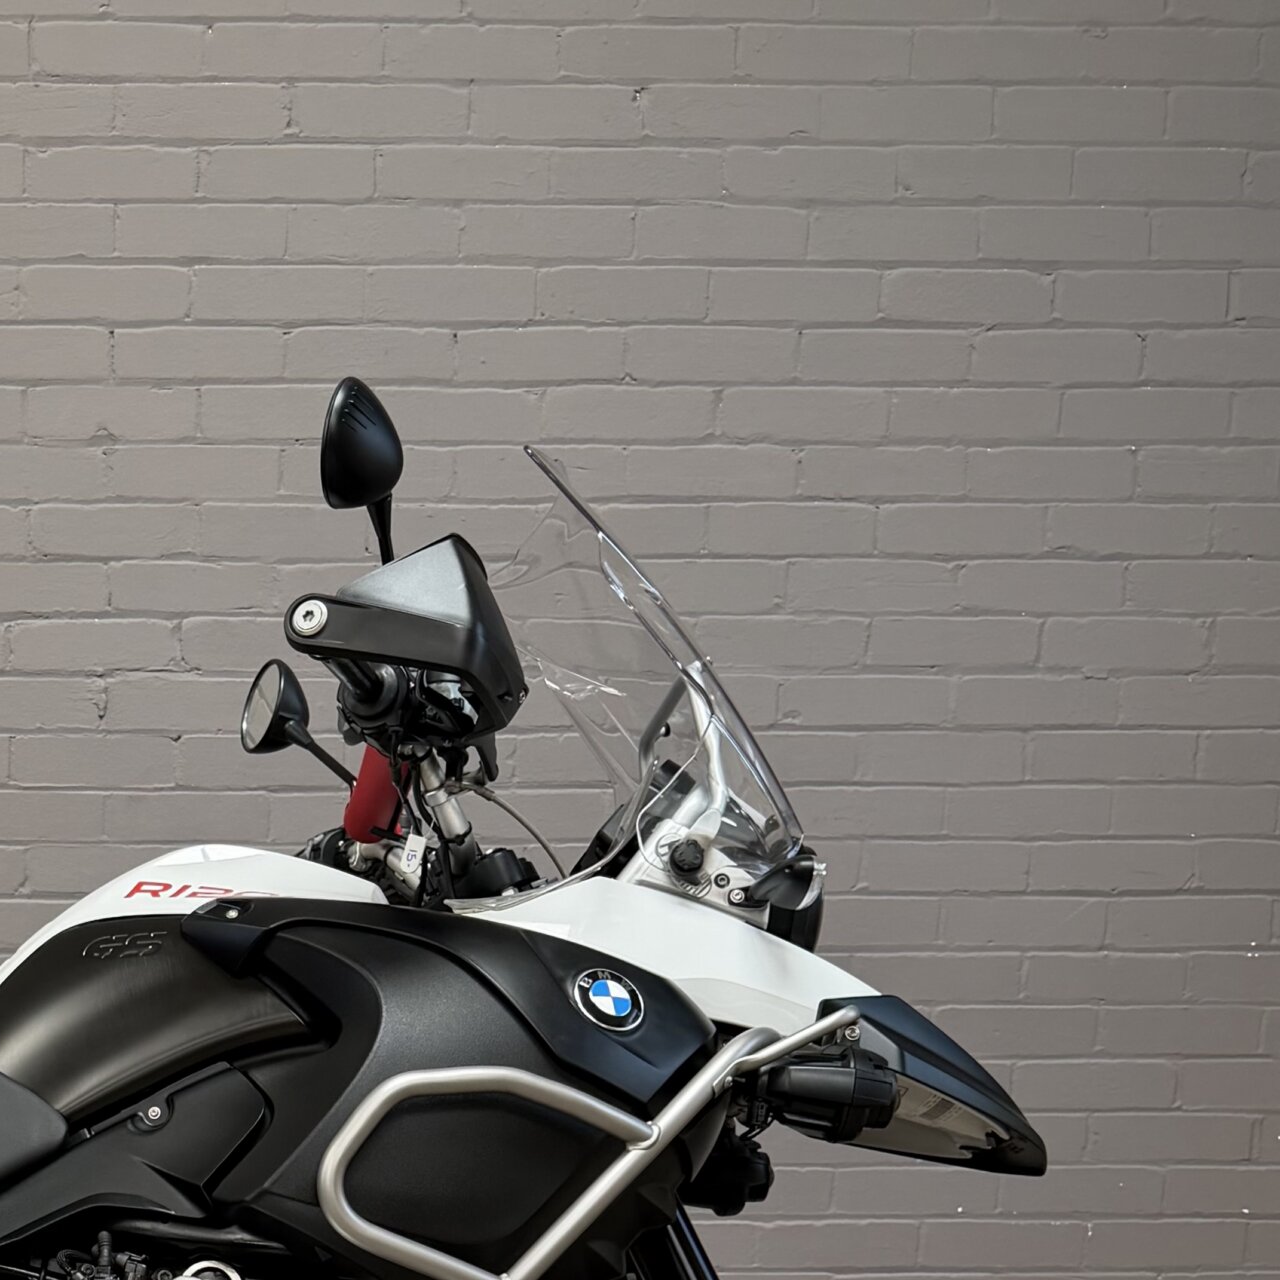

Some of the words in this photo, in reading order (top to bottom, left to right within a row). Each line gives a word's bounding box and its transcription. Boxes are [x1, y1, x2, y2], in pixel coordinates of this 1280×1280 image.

[124, 881, 279, 898] R12
[82, 931, 168, 960] GS
[579, 970, 632, 991] BMW
